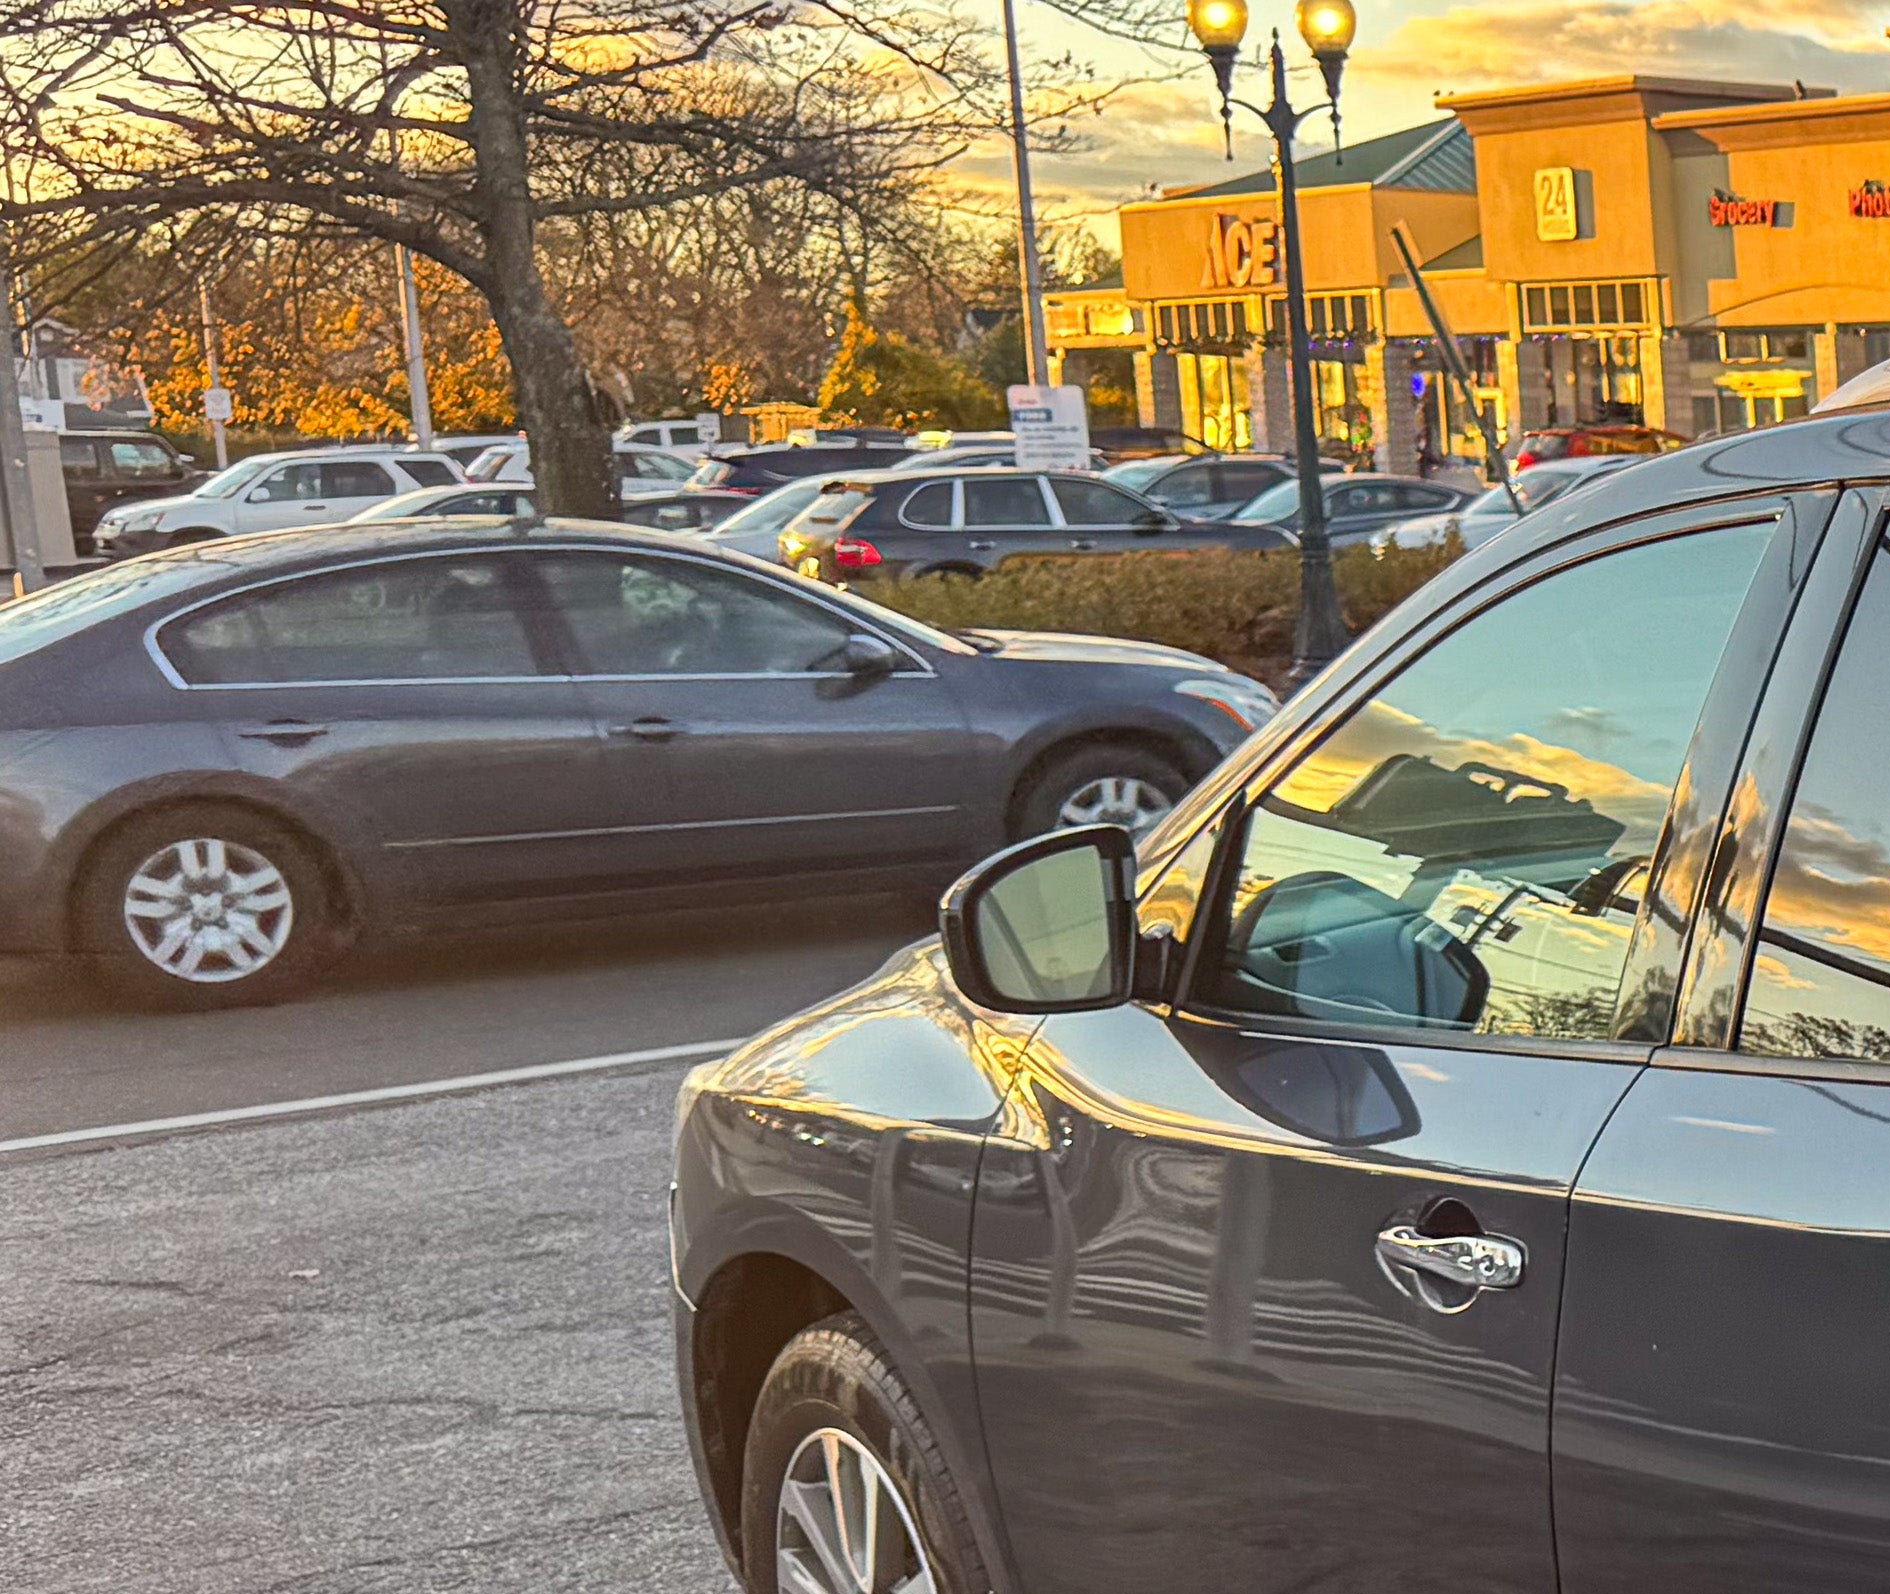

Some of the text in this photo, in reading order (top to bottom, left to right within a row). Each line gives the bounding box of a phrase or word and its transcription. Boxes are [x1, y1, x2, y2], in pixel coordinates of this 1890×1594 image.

[1541, 173, 1568, 216] 24
[1709, 195, 1775, 227] Grocery
[1201, 211, 1276, 287] ACE
